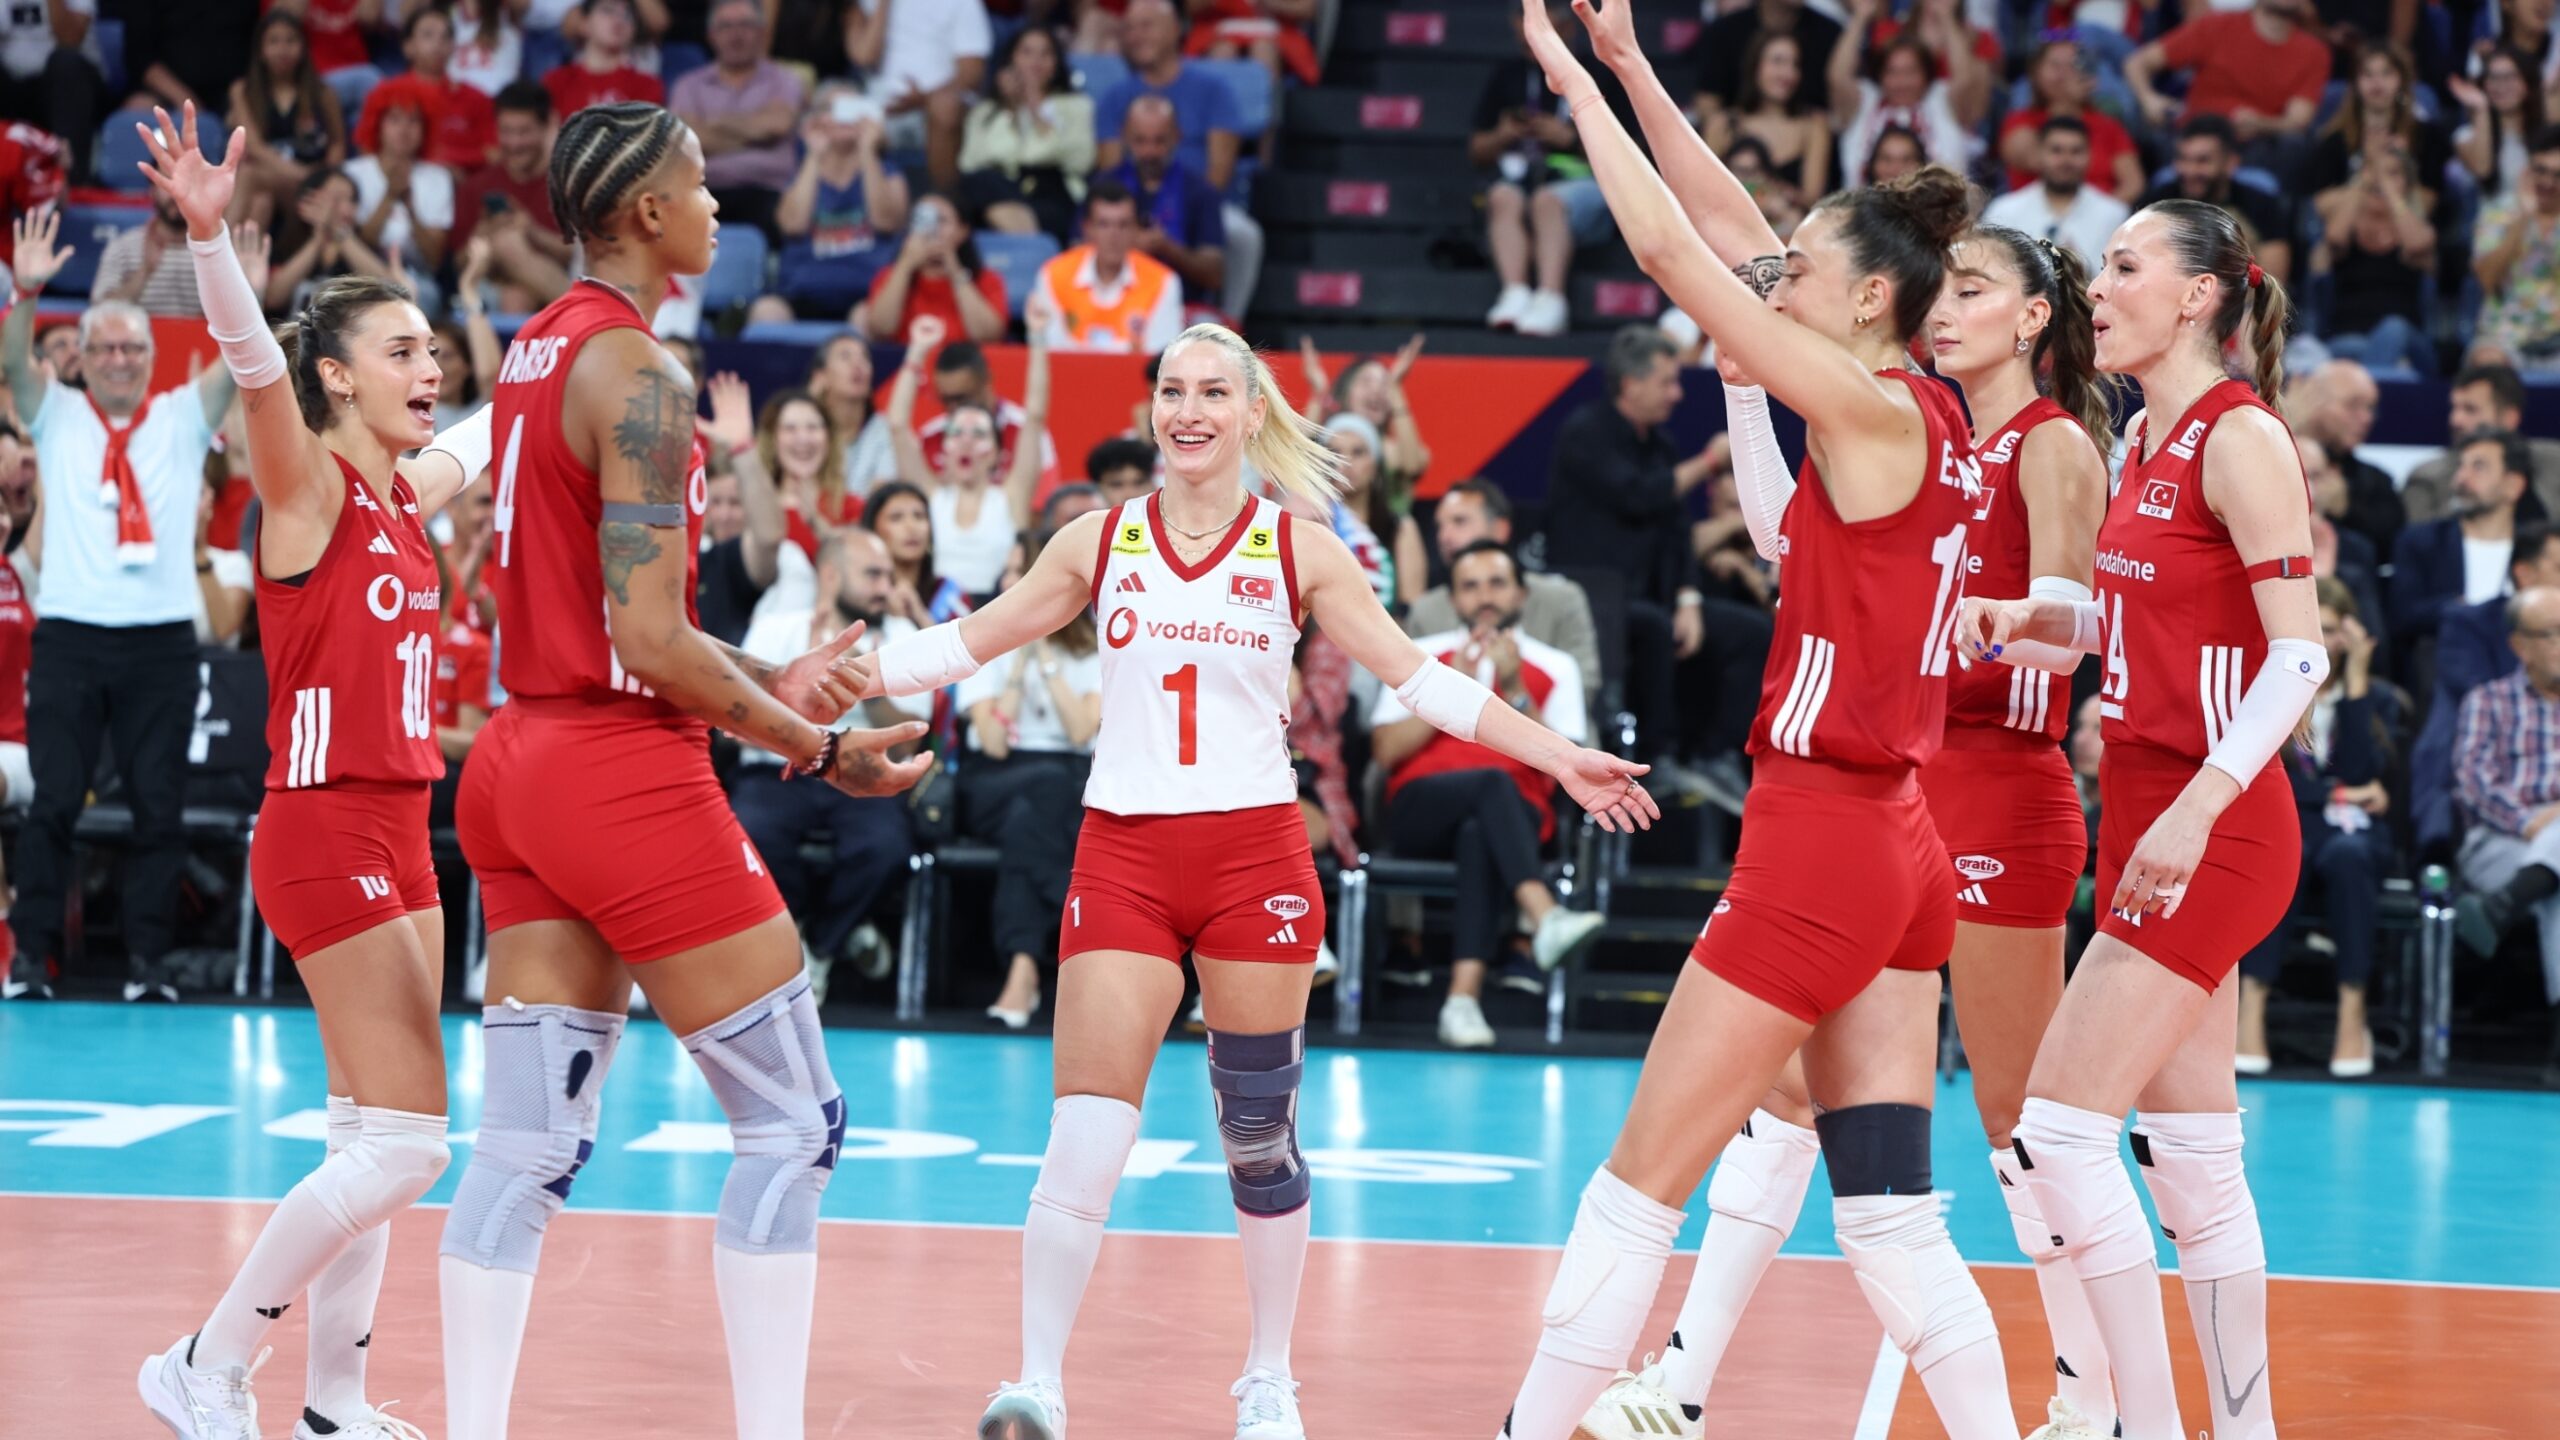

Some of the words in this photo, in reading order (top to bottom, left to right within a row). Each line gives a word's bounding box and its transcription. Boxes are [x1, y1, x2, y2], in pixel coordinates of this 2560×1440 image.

[494, 414, 524, 568] 4
[2145, 506, 2164, 516] TUR
[2096, 548, 2156, 582] vodafone
[1239, 596, 1264, 607] TUR
[1146, 620, 1270, 652] vodafone
[396, 631, 432, 740] 10
[1162, 663, 1198, 766] 1
[741, 841, 764, 877] 4
[1958, 858, 1999, 872] gratis
[1070, 896, 1080, 928] 1
[1269, 898, 1307, 911] gratis
